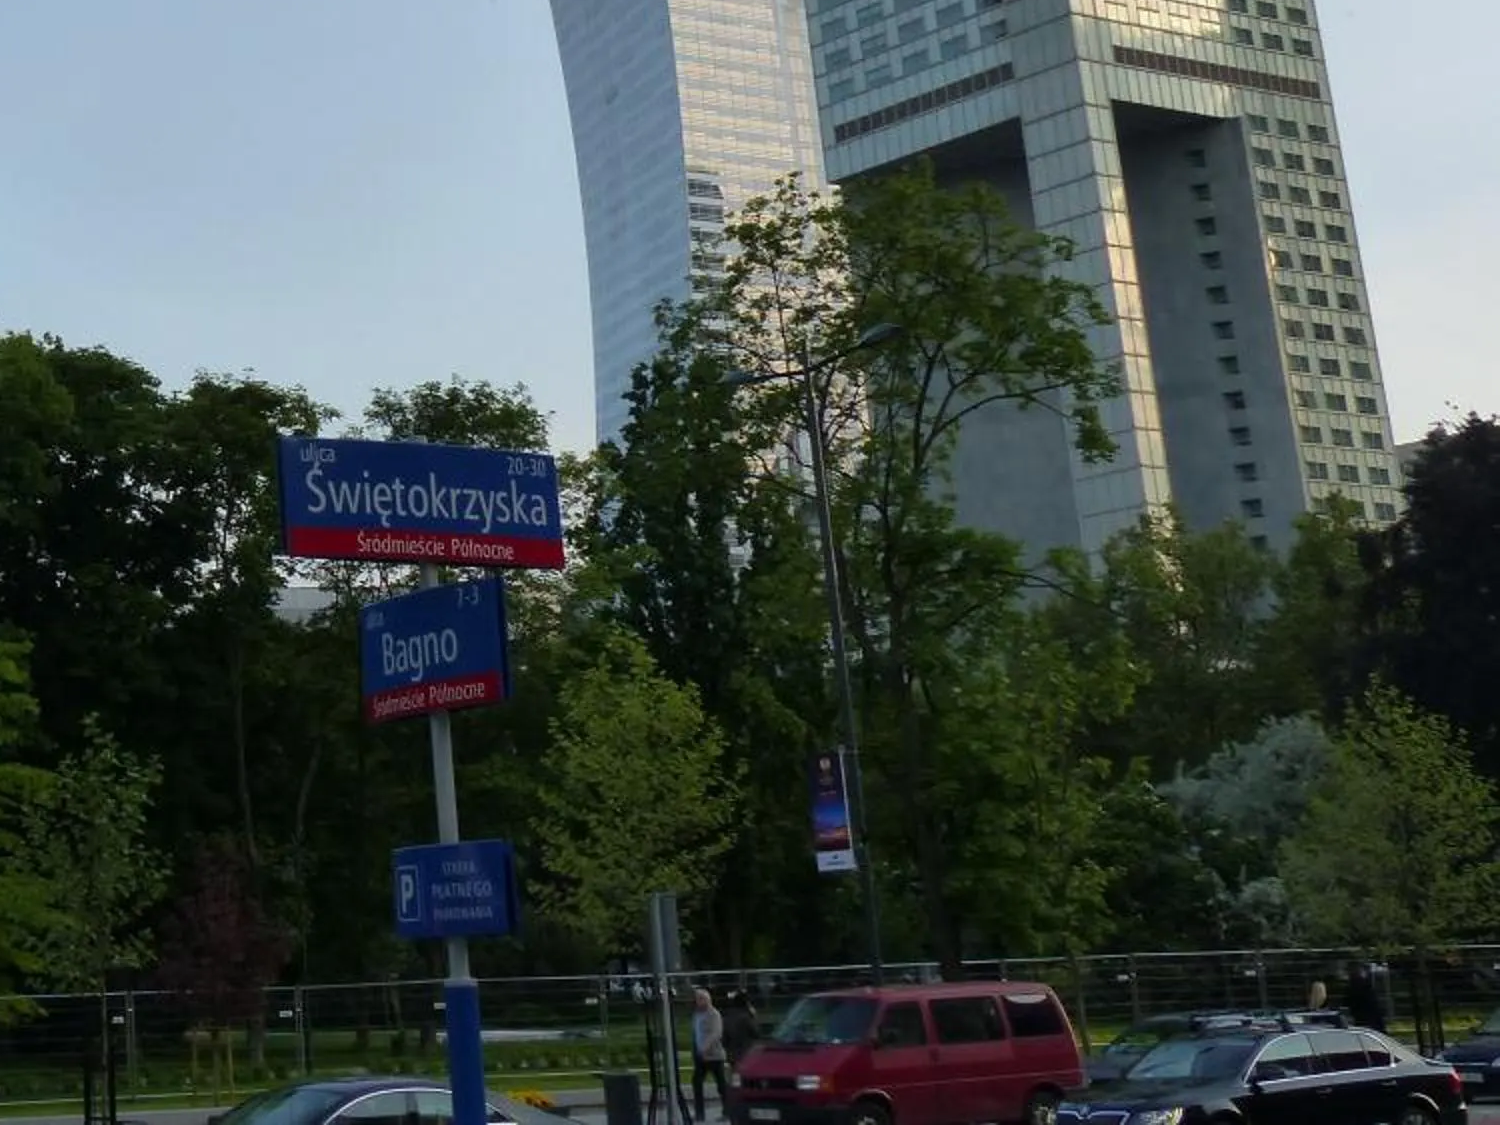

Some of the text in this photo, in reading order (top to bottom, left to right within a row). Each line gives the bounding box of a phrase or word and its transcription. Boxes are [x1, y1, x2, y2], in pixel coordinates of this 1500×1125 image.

[301, 442, 336, 463] ulica
[507, 455, 547, 476] 20-30
[305, 460, 548, 533] Świętokrzyska
[356, 530, 515, 561] Śródmieście Północne
[381, 627, 458, 682] Bagno
[429, 682, 485, 706] Północne
